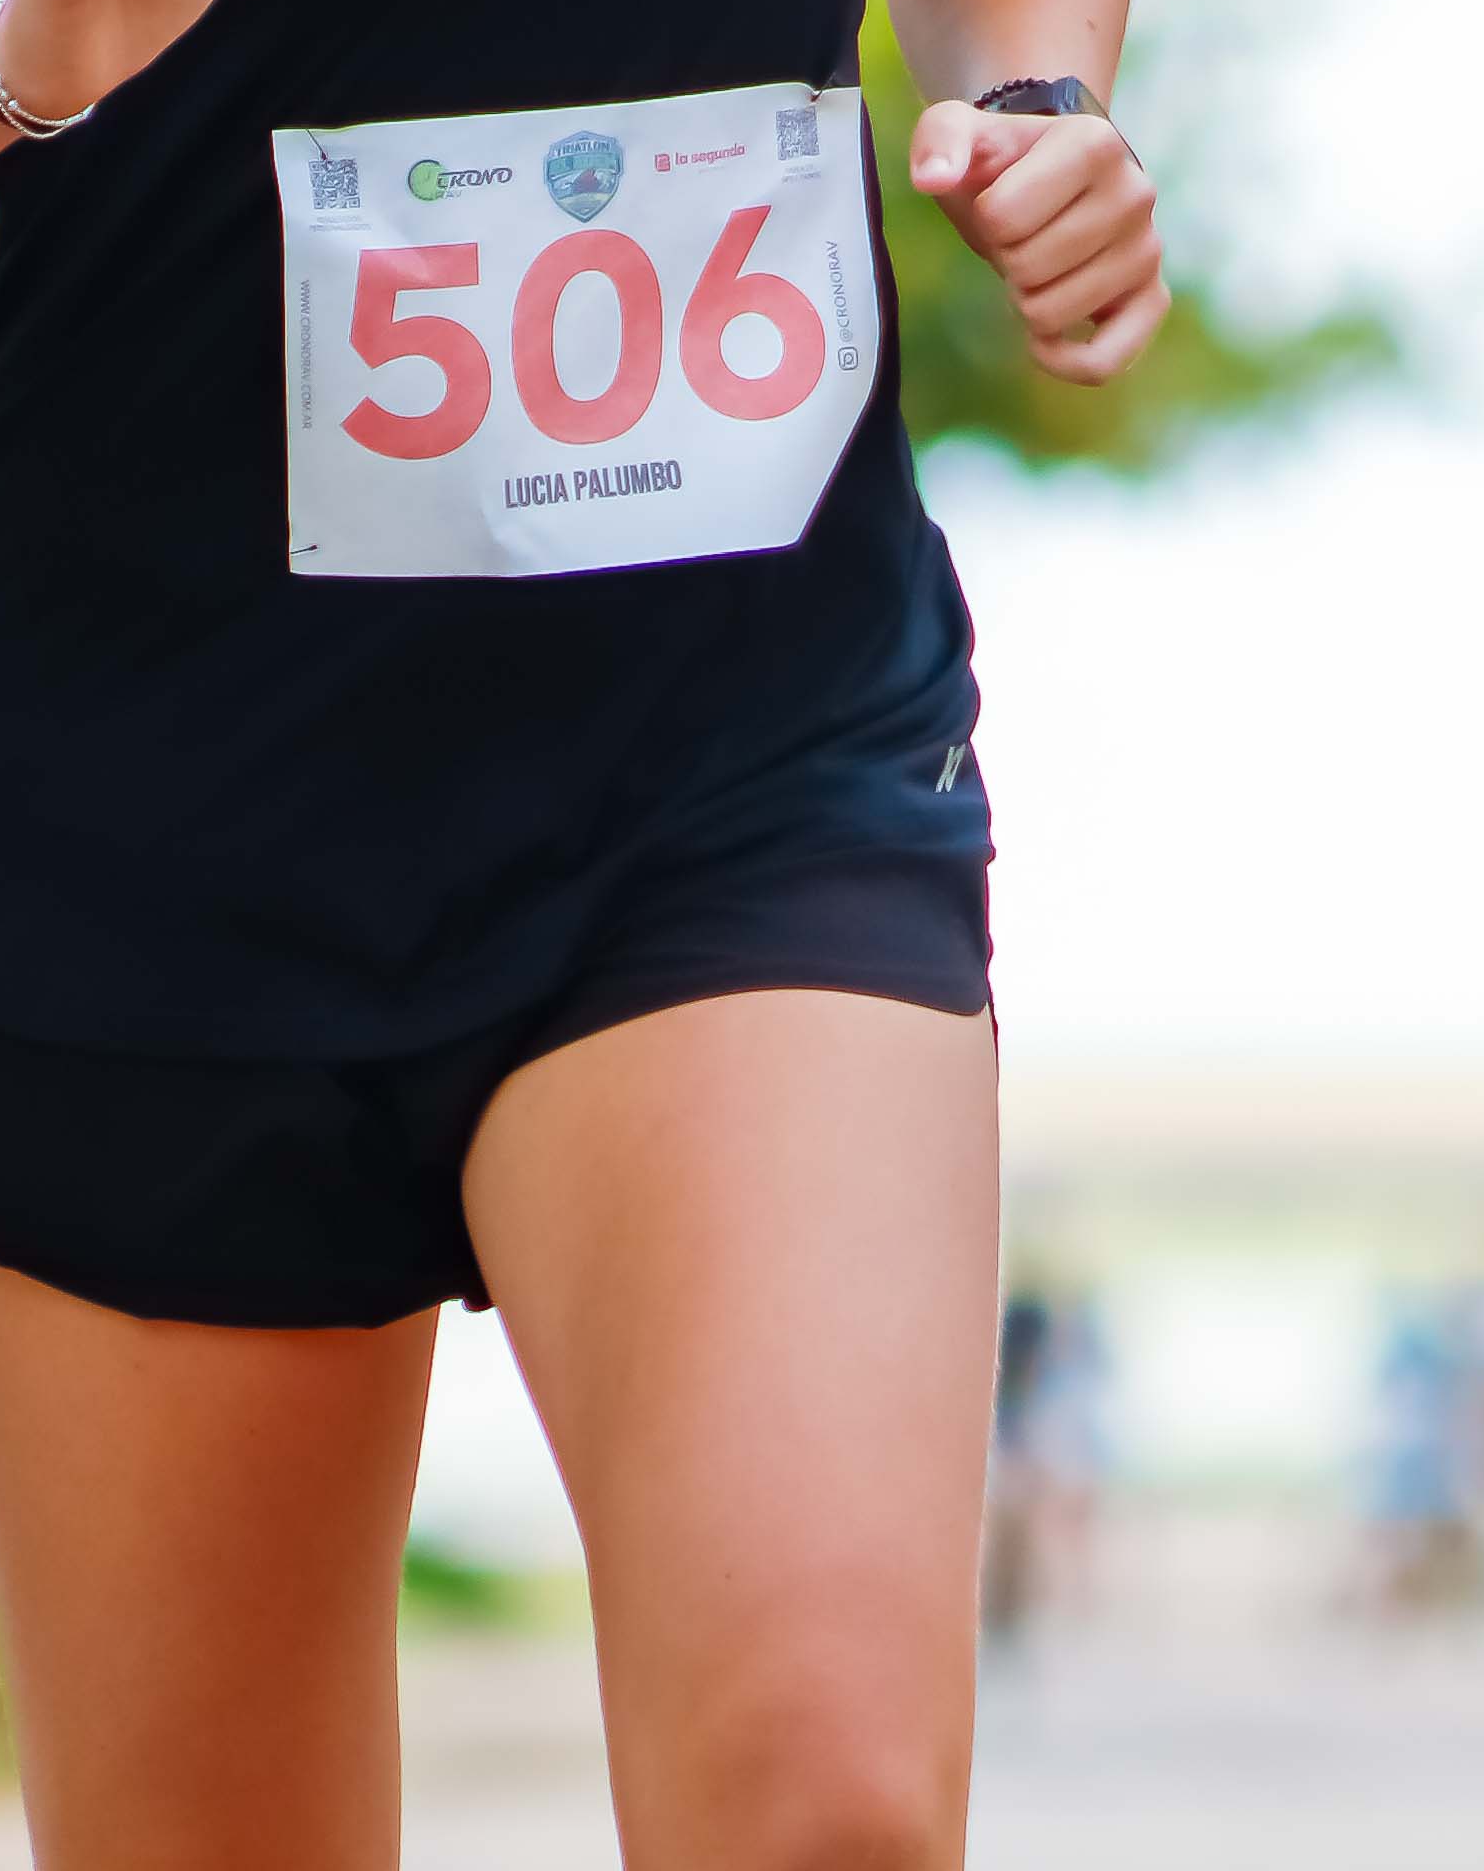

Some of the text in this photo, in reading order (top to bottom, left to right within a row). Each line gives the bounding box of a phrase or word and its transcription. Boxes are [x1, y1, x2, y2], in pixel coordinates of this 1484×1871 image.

[675, 143, 746, 165] la segunda
[825, 240, 854, 343] @CRONORAV
[340, 205, 826, 460] 506
[505, 460, 683, 509] LUCIA PALUMBO
